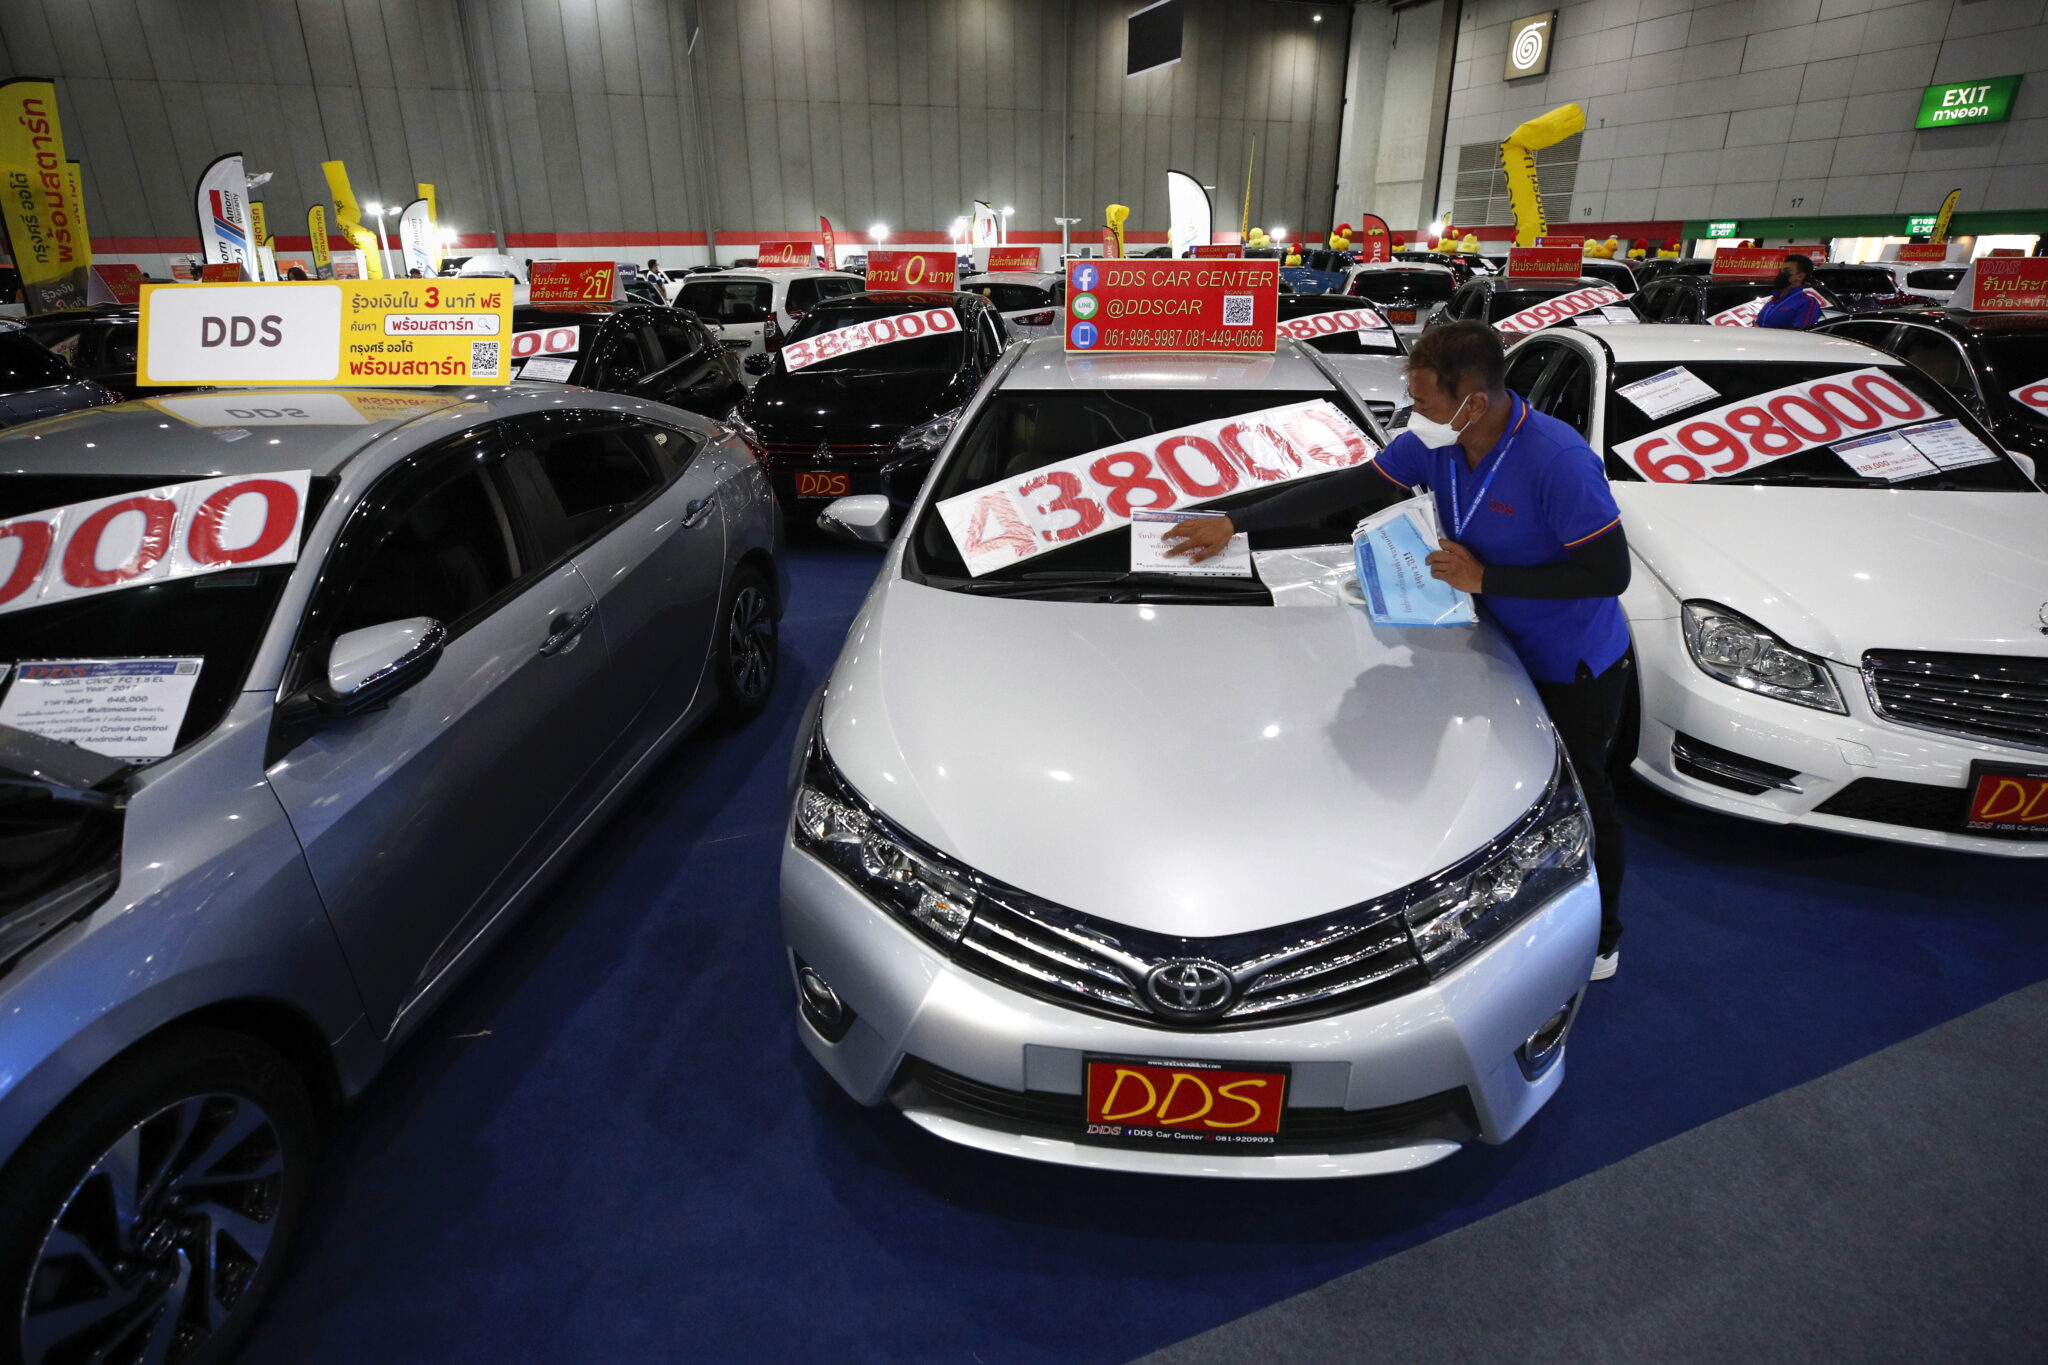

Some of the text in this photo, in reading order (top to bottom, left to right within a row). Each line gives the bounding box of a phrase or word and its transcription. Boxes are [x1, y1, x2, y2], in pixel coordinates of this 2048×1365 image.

[1942, 85, 1991, 107] EXIT
[1932, 106, 1989, 121] ทางออก
[18, 98, 73, 263] พร้อมสตาร์ท
[224, 190, 236, 223] Amorn
[1583, 208, 1592, 216] 18
[1791, 198, 1804, 208] 17
[10, 172, 49, 264] กรุงศรี ออโต้
[1711, 229, 1732, 237] EXIT
[1912, 225, 1937, 233] EXI
[782, 244, 793, 264] 0
[867, 264, 902, 282] ดาวน์
[905, 255, 926, 284] 0
[929, 271, 954, 283] บาท
[1977, 260, 2021, 275] DDS
[533, 273, 570, 285] รับประกัน
[582, 268, 612, 299] 2ปี
[1106, 270, 1274, 288] DDS CAR CENTER
[352, 286, 501, 314] รู้วงเงินใน 3 นาที ฟรี
[1106, 299, 1203, 319] @DDSCAR
[202, 314, 283, 348] DDS
[350, 316, 474, 332] ค้นหา พร้อมสตาร์ท
[1104, 328, 1264, 347] 061-996-9987.081-449-0666
[350, 339, 414, 356] กรุงศรี ออโต้
[349, 355, 466, 376] พร้อมสตาร์ท
[1633, 374, 1926, 483] 698000
[801, 473, 846, 495] DDS
[965, 408, 1373, 559] 438000
[28, 665, 90, 679] DDS
[85, 677, 114, 685] CIVIC
[132, 724, 168, 732] Control
[85, 735, 123, 743] Android
[1101, 1069, 1268, 1129] DDS
[1086, 1124, 1122, 1135] DDS
[1133, 1129, 1153, 1137] DDS
[1174, 1132, 1204, 1141] Center
